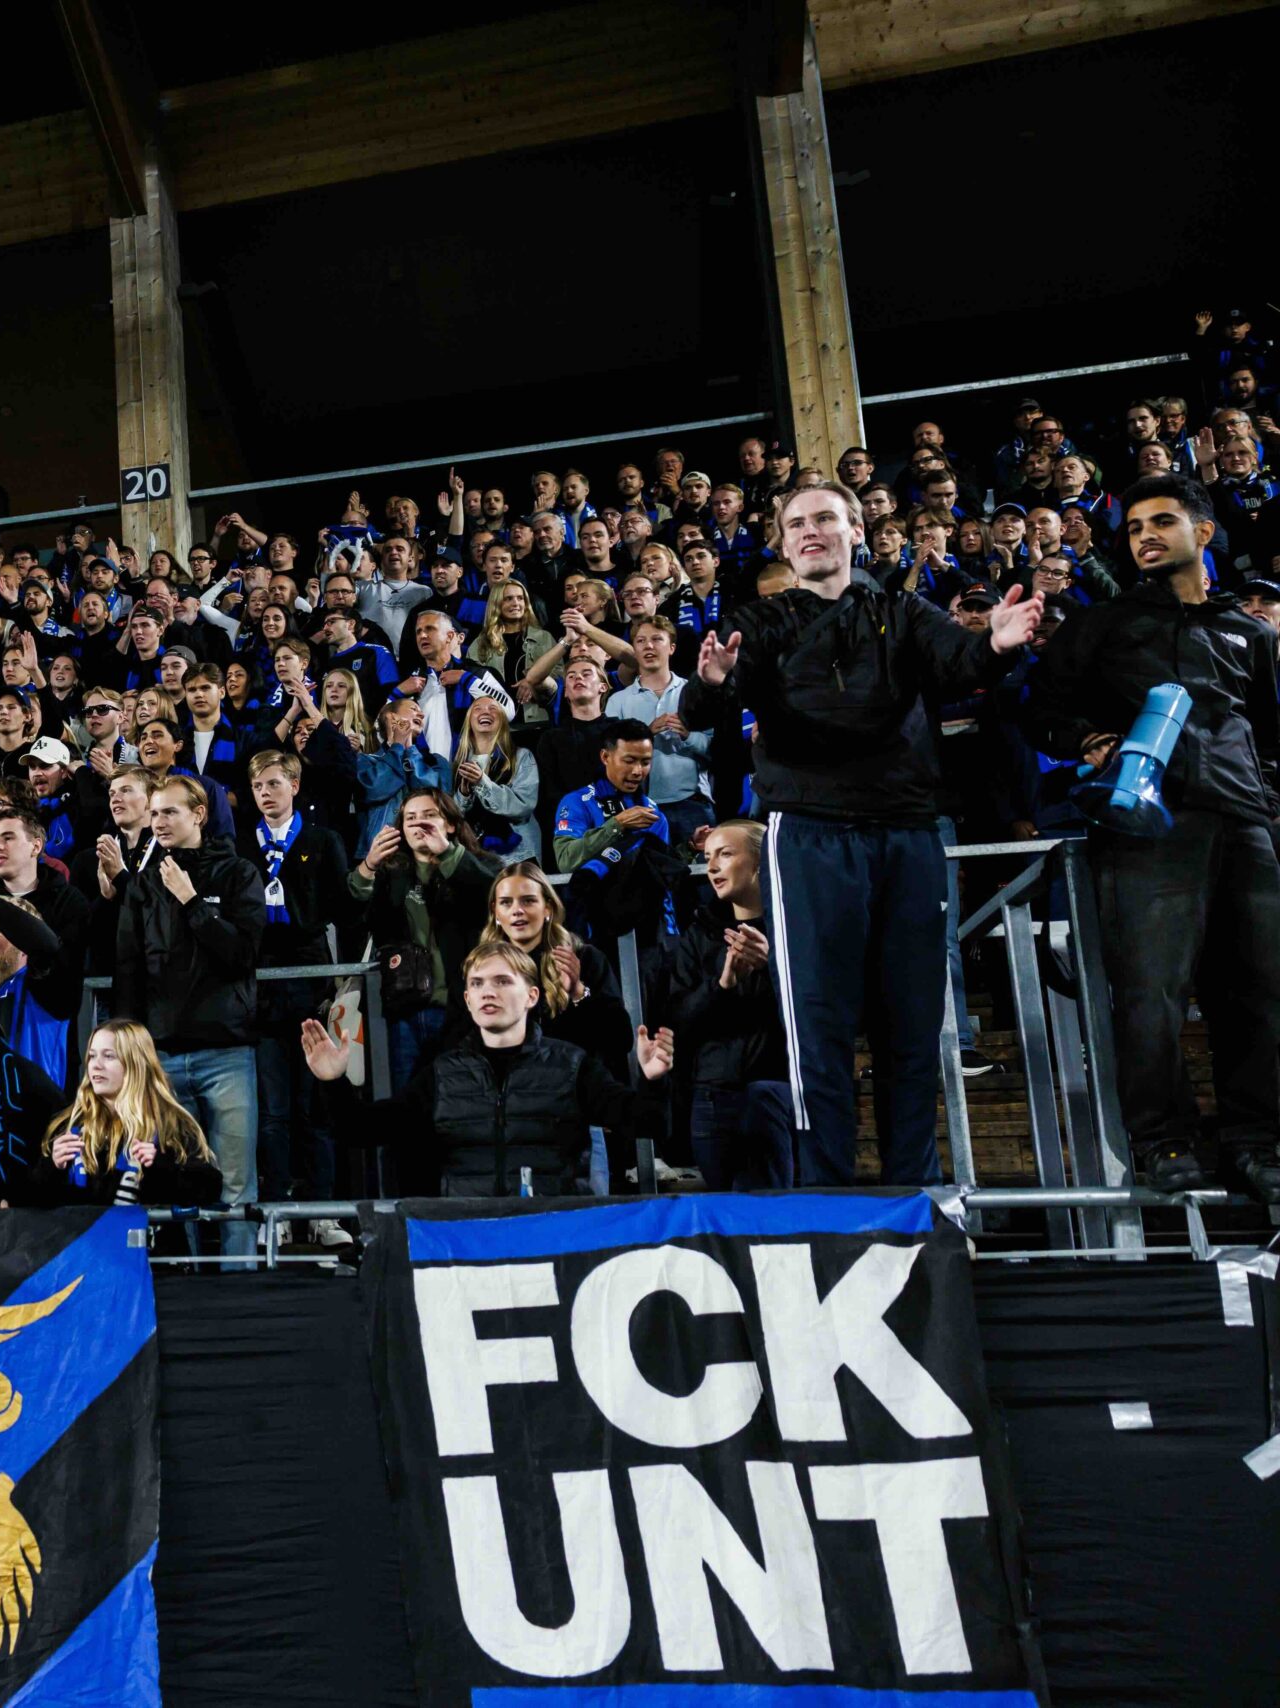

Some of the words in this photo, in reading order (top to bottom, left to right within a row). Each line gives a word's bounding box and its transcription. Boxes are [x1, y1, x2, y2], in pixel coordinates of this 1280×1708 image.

[124, 467, 167, 500] 20
[412, 1243, 974, 1456] FCK
[440, 1455, 989, 1678] UNT
